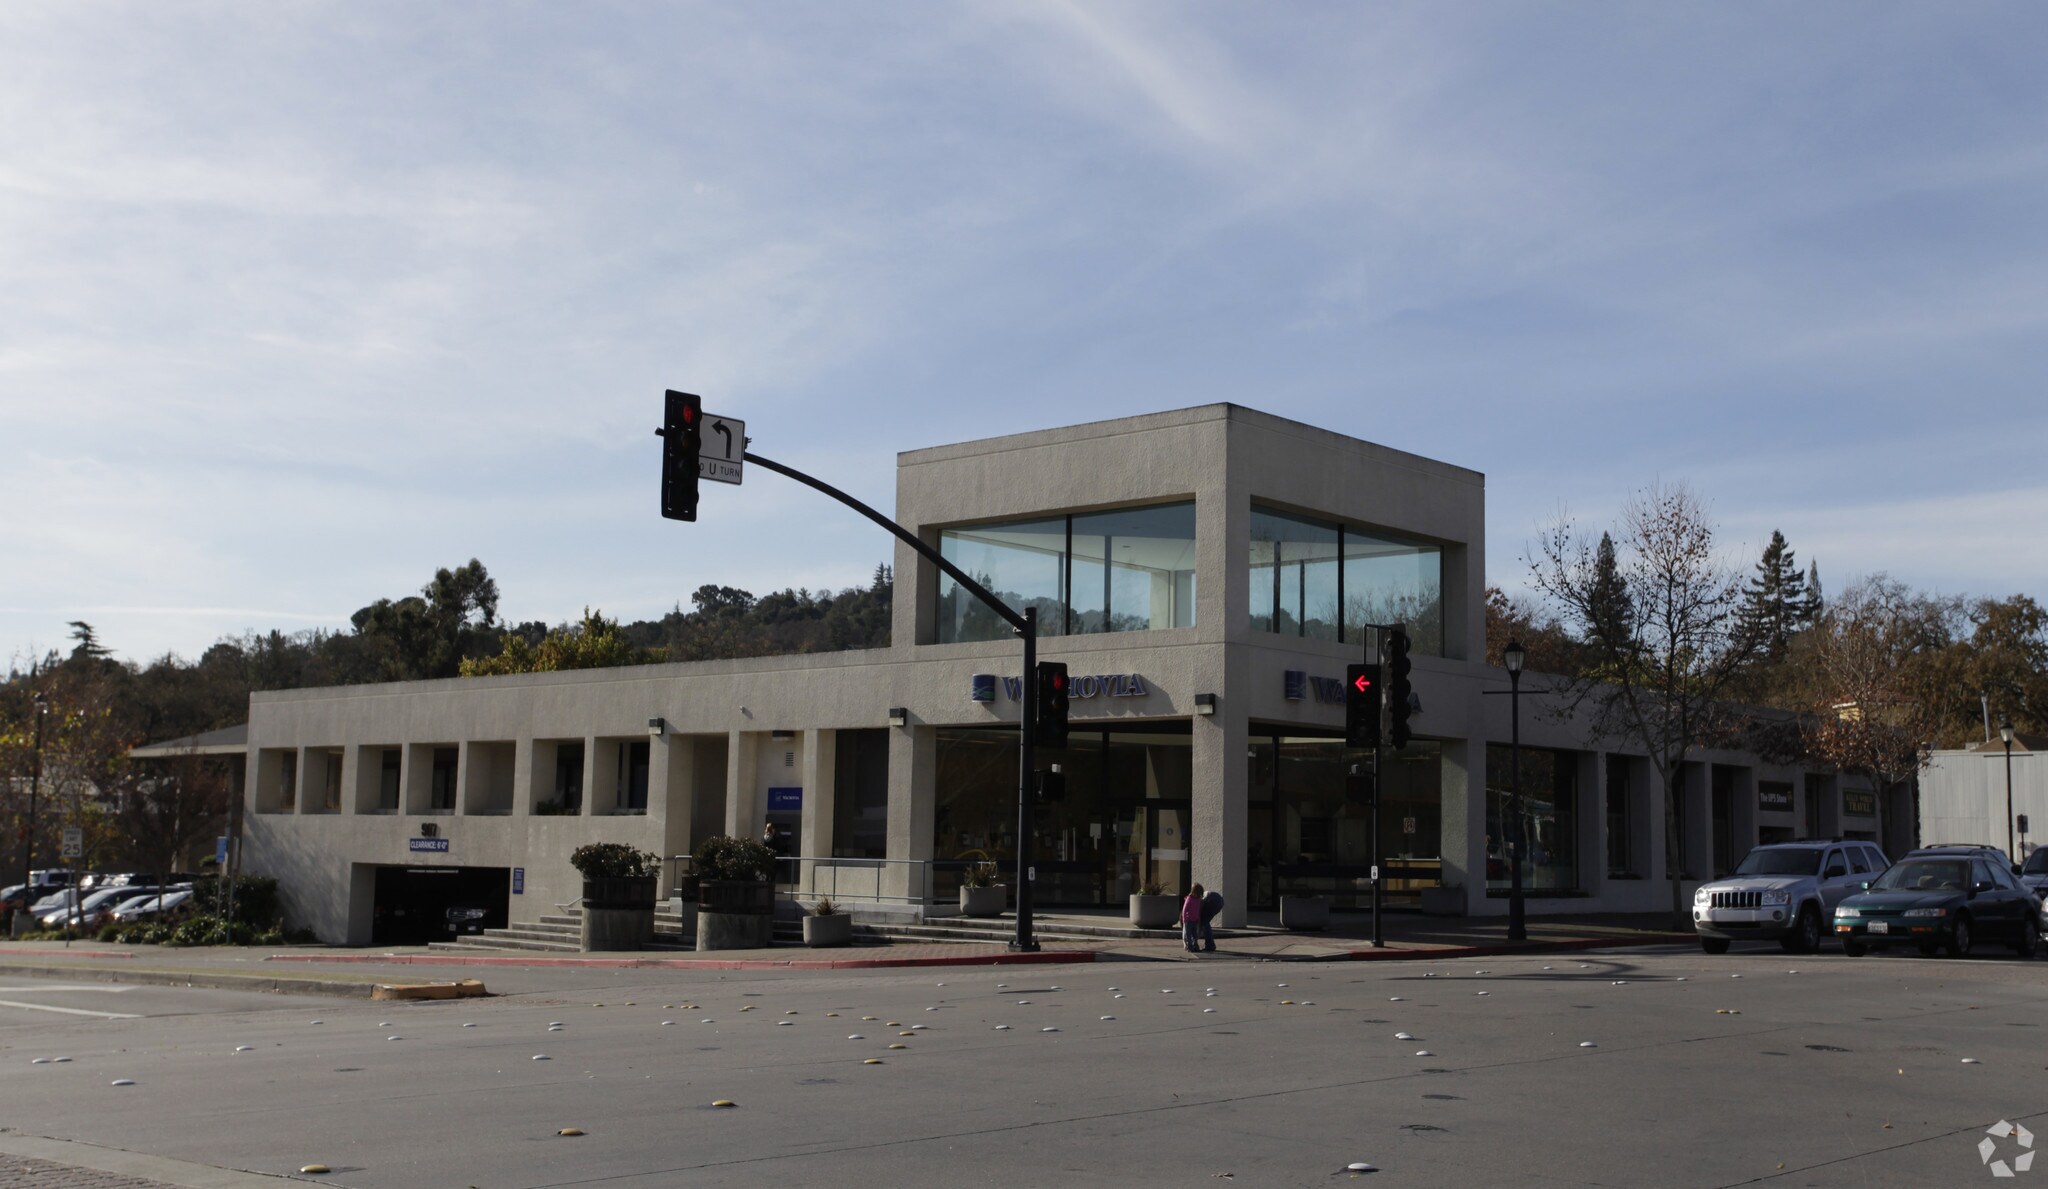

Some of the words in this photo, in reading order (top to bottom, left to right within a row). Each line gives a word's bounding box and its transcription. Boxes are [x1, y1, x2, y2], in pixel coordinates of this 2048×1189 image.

[709, 462, 717, 475] U
[720, 466, 740, 478] TURN
[64, 844, 80, 855] 25
